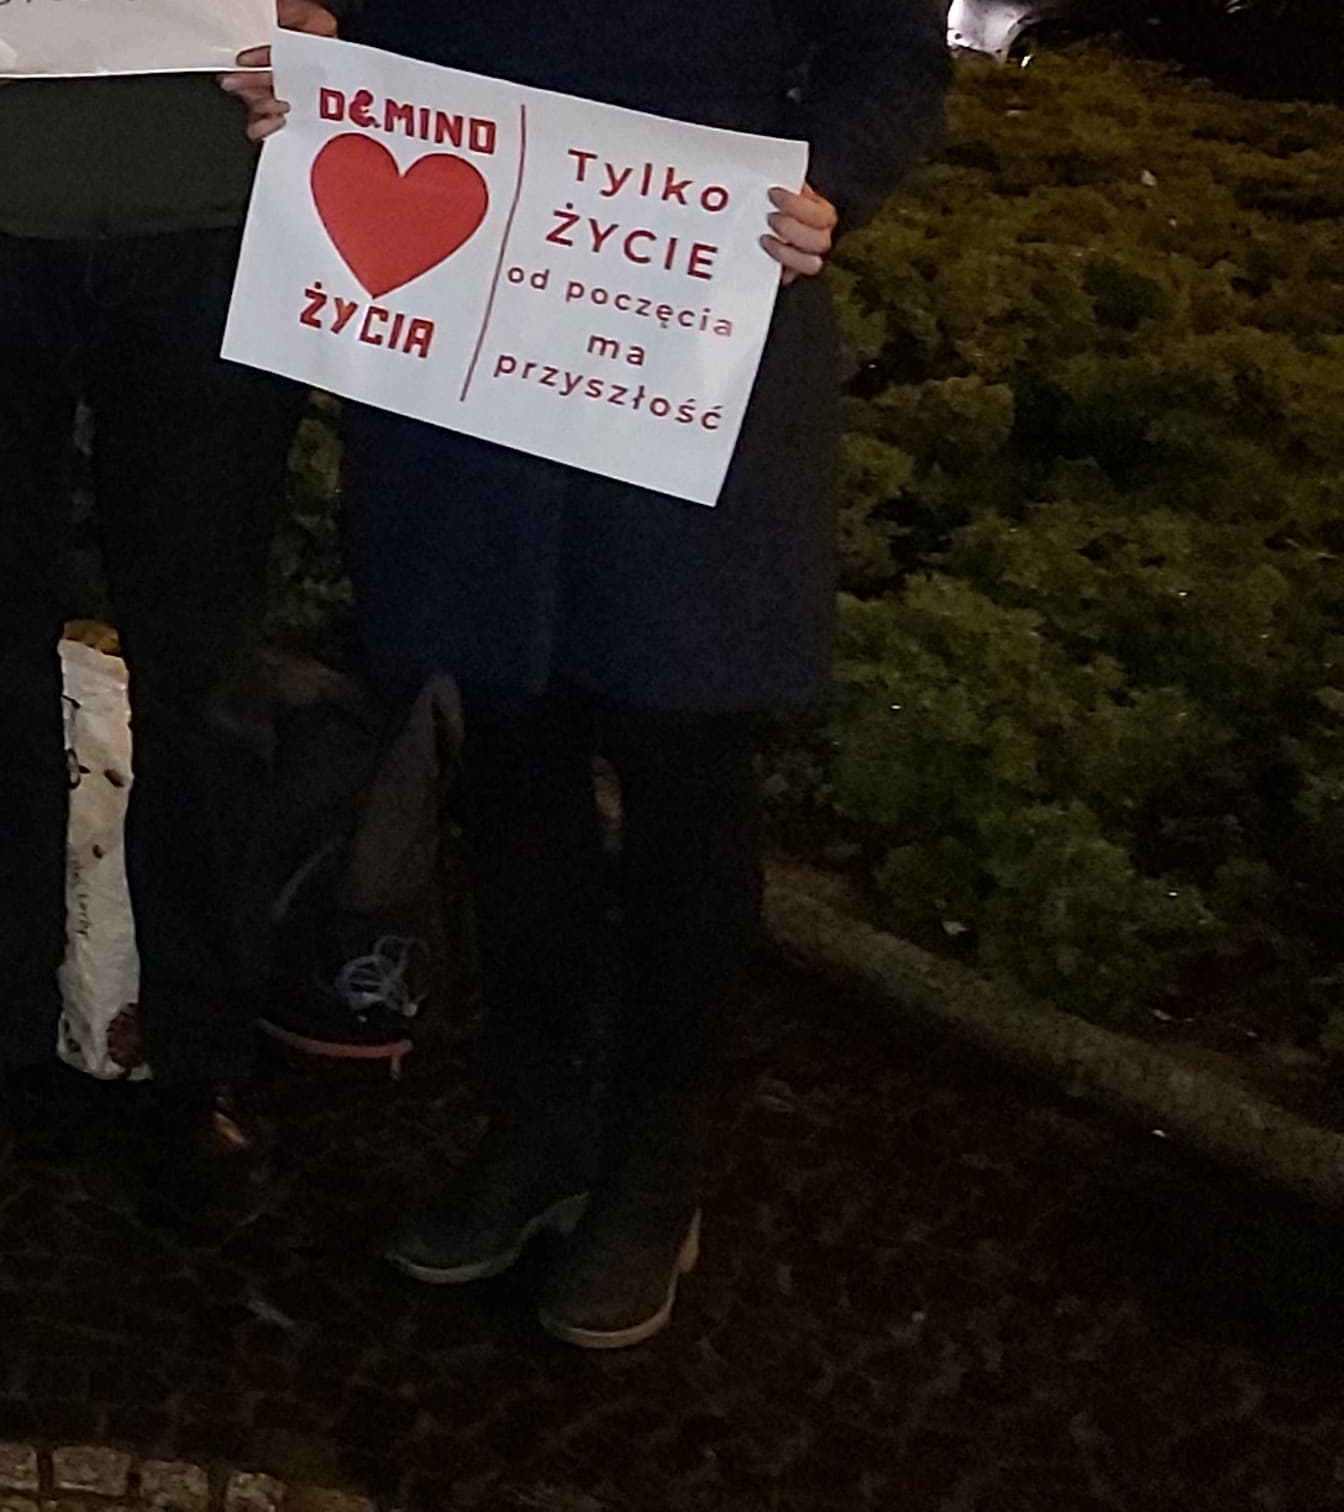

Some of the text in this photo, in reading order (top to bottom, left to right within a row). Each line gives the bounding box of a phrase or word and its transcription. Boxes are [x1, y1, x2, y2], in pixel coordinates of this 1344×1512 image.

[568, 149, 730, 212] Tylko
[546, 203, 719, 280] ŻYCIE
[299, 282, 435, 359] ŻYCIA
[507, 265, 734, 338] od poczęcia
[587, 333, 647, 367] ma
[493, 351, 724, 431] przyszłość
